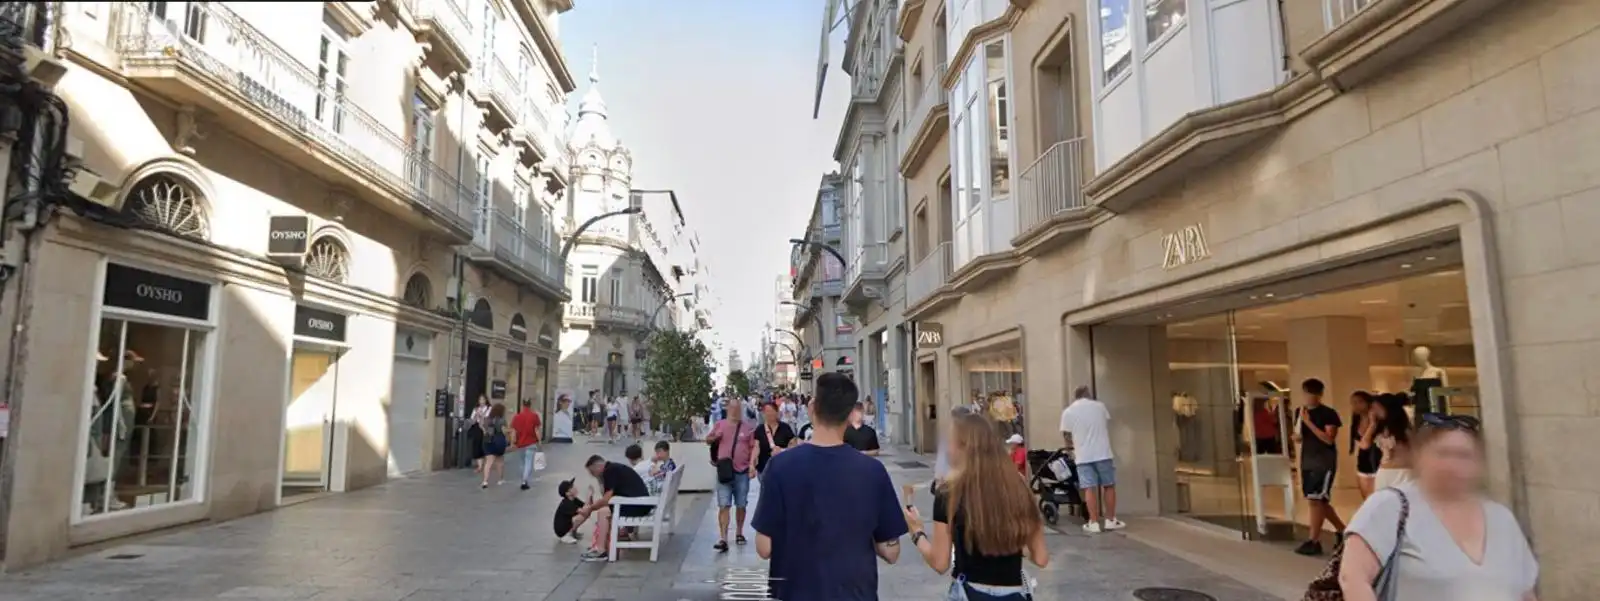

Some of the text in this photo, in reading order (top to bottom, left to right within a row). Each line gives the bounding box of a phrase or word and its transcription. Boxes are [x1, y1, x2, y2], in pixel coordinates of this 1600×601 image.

[271, 231, 306, 240] OYSHO
[1161, 222, 1210, 269] ZARA
[137, 283, 182, 303] OYSHO
[308, 318, 334, 331] OYSHO
[918, 331, 941, 343] ZARA
